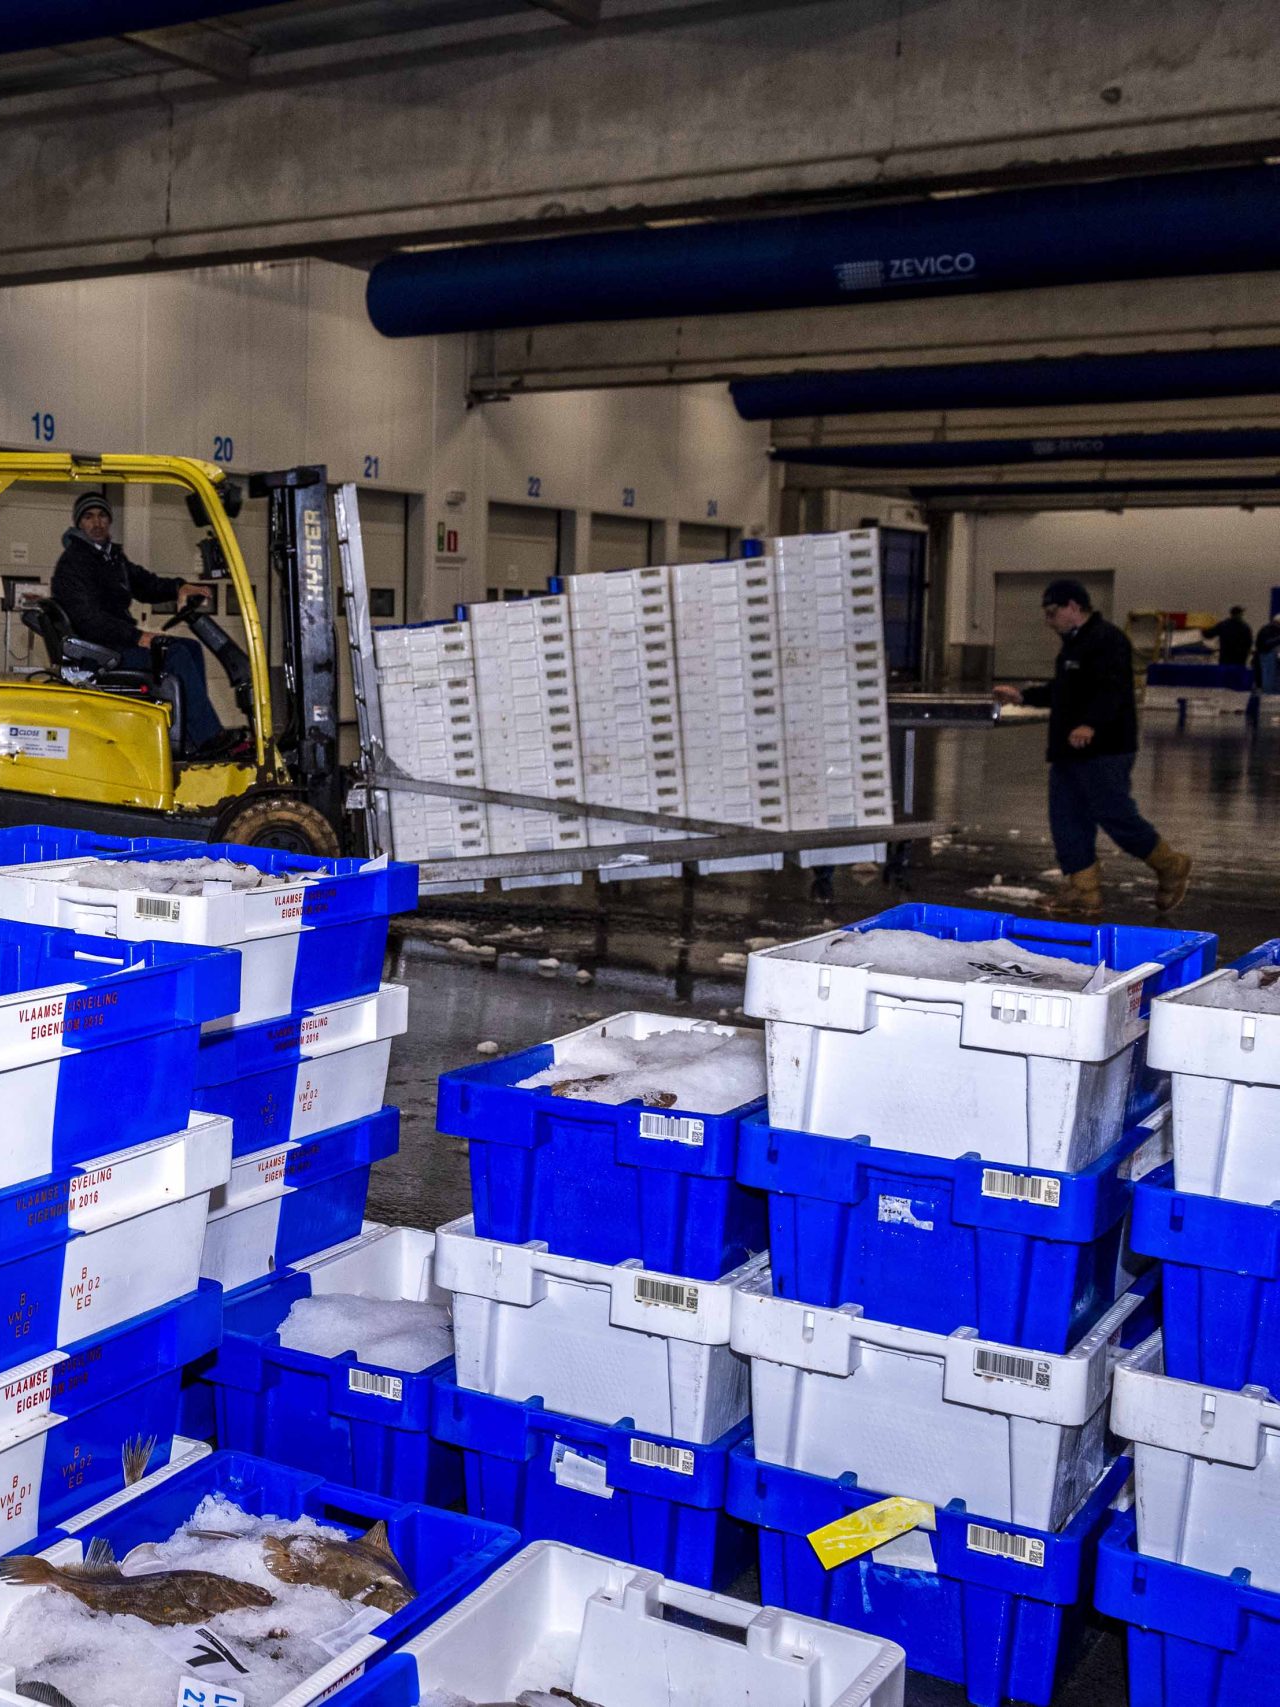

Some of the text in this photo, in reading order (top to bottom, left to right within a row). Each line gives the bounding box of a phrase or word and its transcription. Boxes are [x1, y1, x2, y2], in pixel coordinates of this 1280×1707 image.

[889, 252, 976, 279] ZEVICO
[31, 412, 55, 442] 19
[213, 436, 233, 462] 20
[363, 455, 380, 479] 21
[527, 476, 542, 498] 22
[623, 487, 635, 508] 23
[304, 510, 325, 602] HYSTER
[274, 893, 303, 906] VLAAMSE
[19, 1002, 64, 1023] VLAAMSE
[31, 1018, 80, 1040] EIGENDOM
[295, 1016, 328, 1034] SVEILING
[79, 1190, 99, 1208] 2016
[81, 1266, 88, 1279] B
[70, 1276, 100, 1298] VM 02
[20, 1292, 26, 1306] B
[76, 1294, 92, 1310] EG
[15, 1321, 30, 1338] EG
[4, 1369, 48, 1401] VLAAMSE
[73, 1446, 80, 1459] B
[62, 1461, 77, 1478] VM
[12, 1475, 19, 1488] B
[68, 1471, 84, 1489] EG
[0, 1483, 32, 1509] VM 01
[7, 1502, 22, 1520] EG
